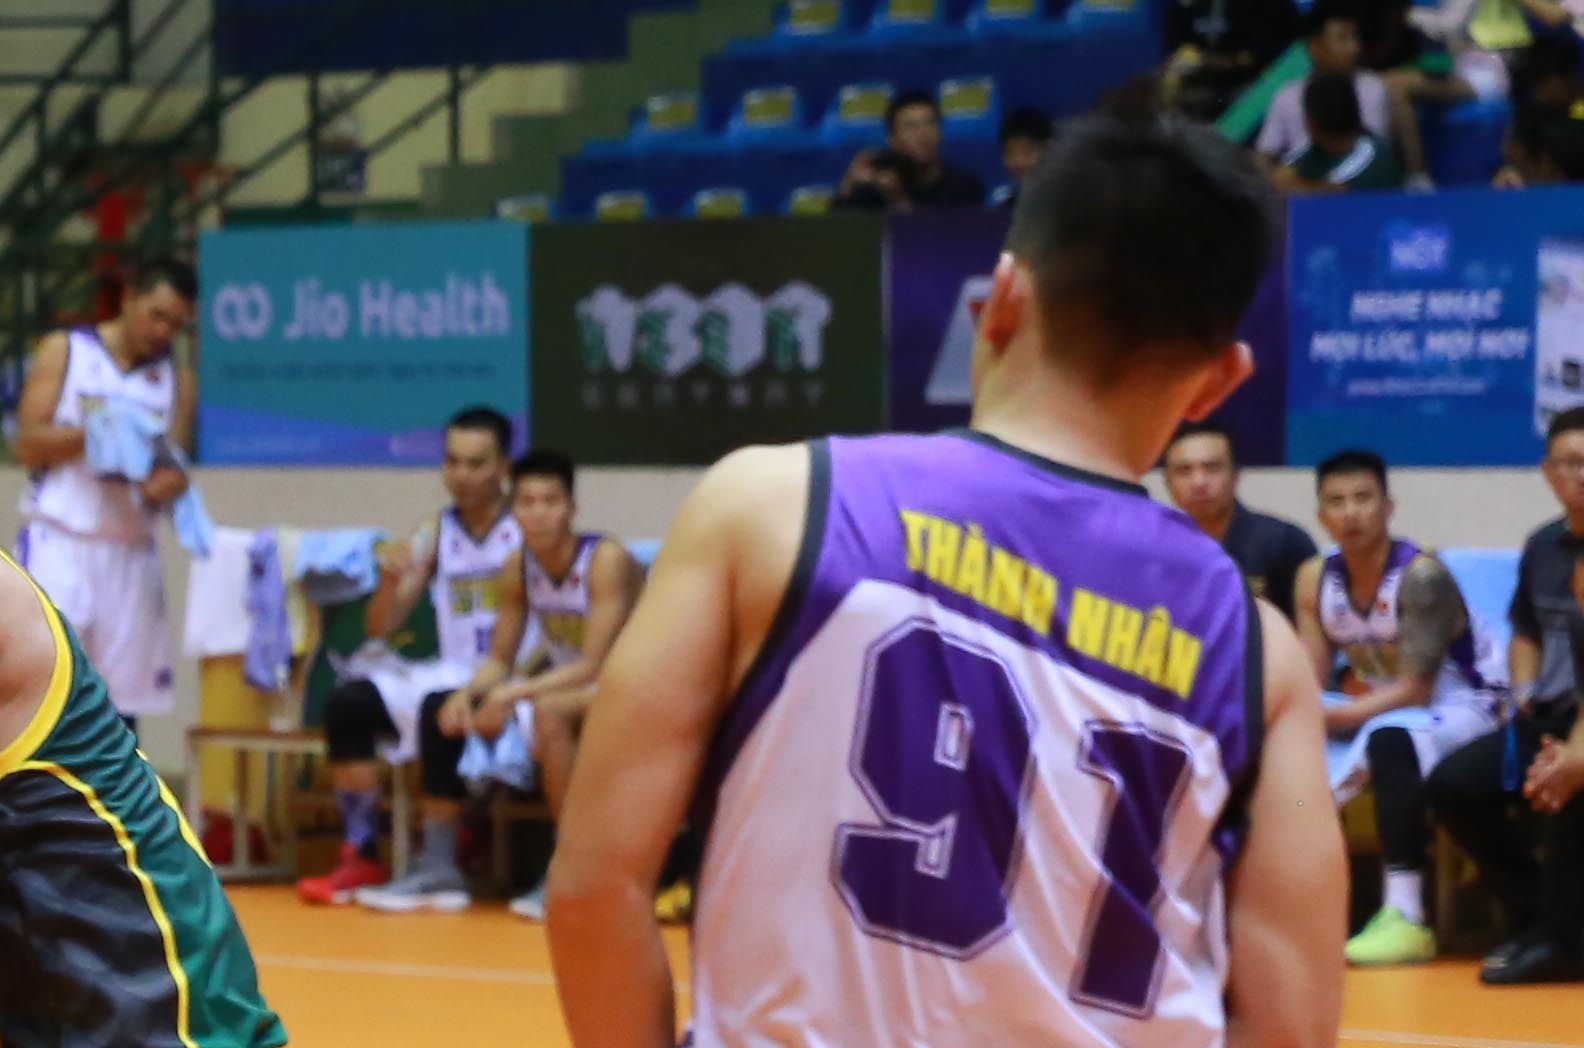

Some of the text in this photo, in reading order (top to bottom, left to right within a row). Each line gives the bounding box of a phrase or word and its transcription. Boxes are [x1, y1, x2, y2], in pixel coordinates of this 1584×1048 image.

[283, 275, 349, 341] Jio
[359, 271, 512, 339] Health
[1066, 587, 1204, 701] NHÂN
[828, 616, 1194, 1020] 91
